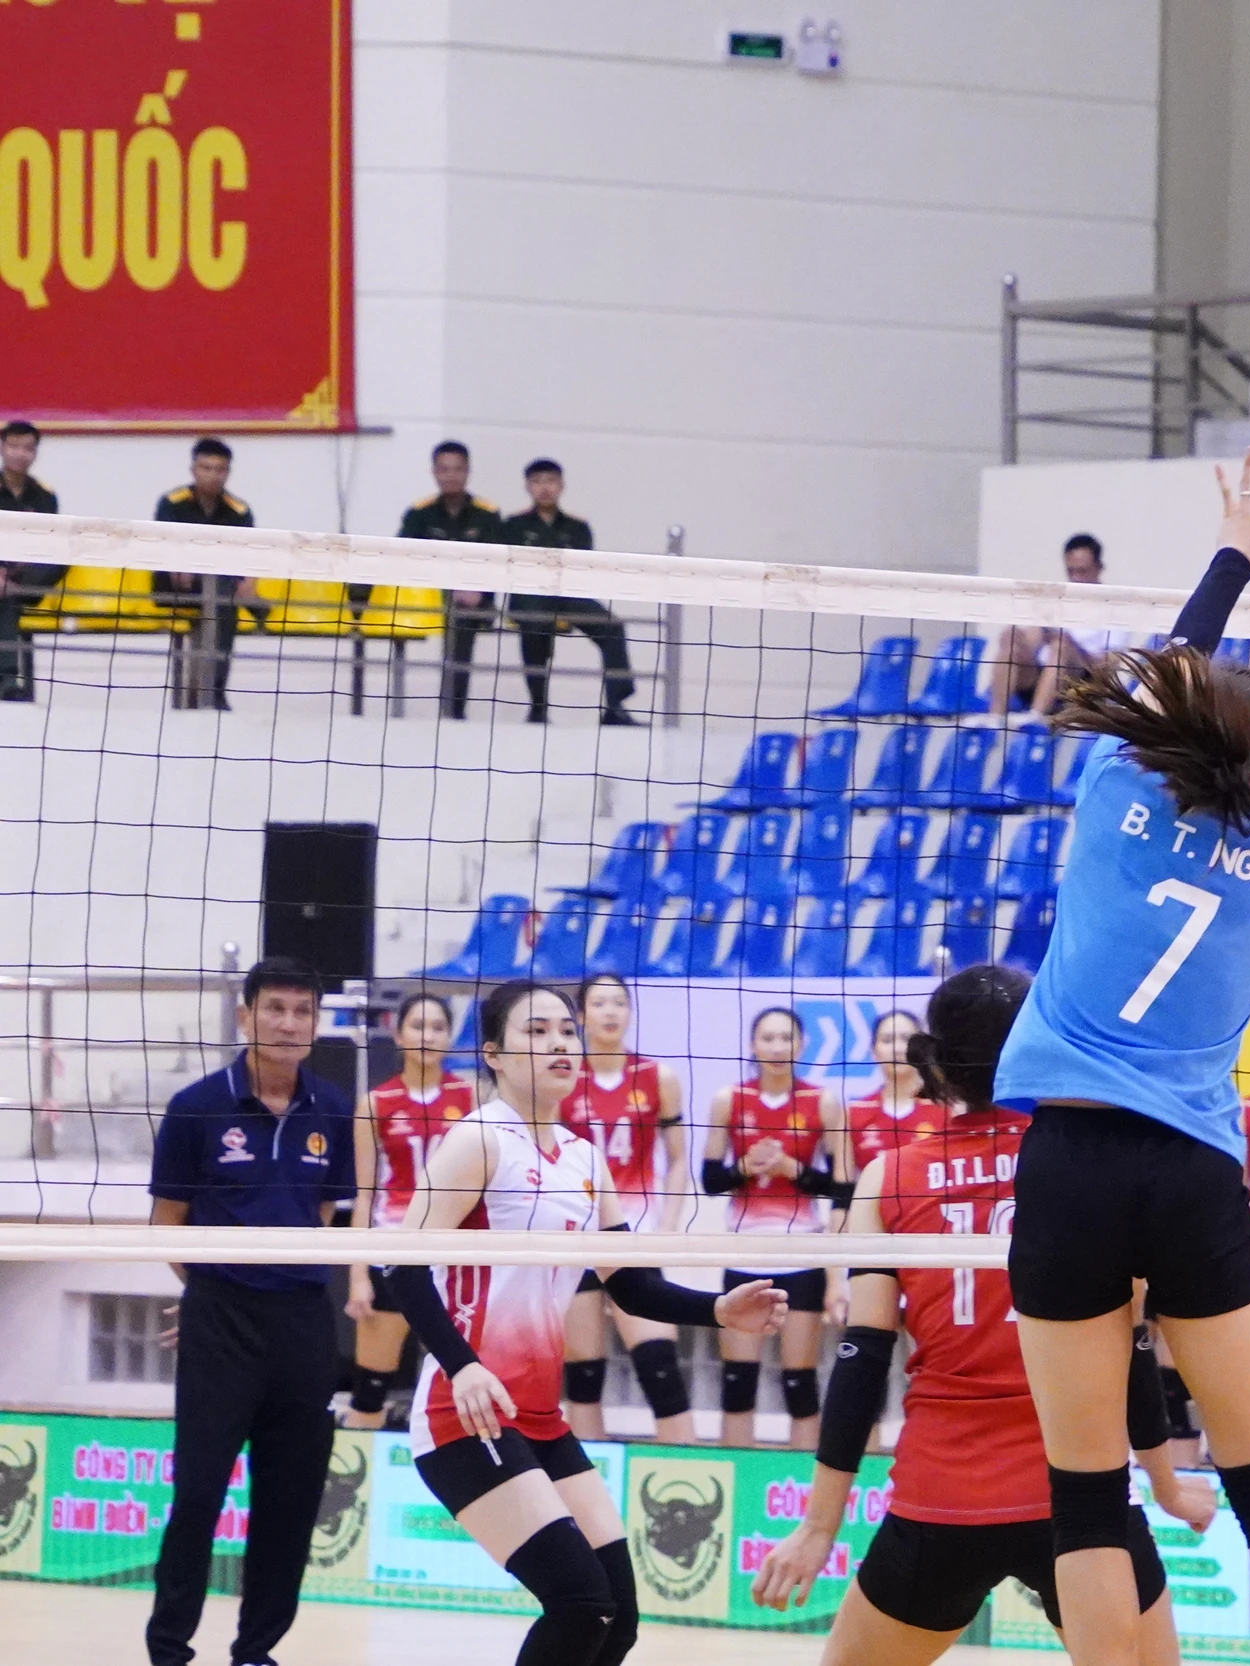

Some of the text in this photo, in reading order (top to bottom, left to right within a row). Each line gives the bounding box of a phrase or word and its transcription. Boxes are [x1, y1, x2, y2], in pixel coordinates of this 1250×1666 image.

[0, 69, 248, 310] QUỐC
[1120, 802, 1150, 840] B.
[1172, 821, 1196, 858] T.
[1119, 877, 1223, 1024] 7
[588, 1115, 634, 1166] 14
[927, 1152, 1019, 1190] Đ.T.LO
[74, 1440, 126, 1480] CÔNG
[133, 1450, 156, 1483] TY
[768, 1478, 813, 1518] CÔN
